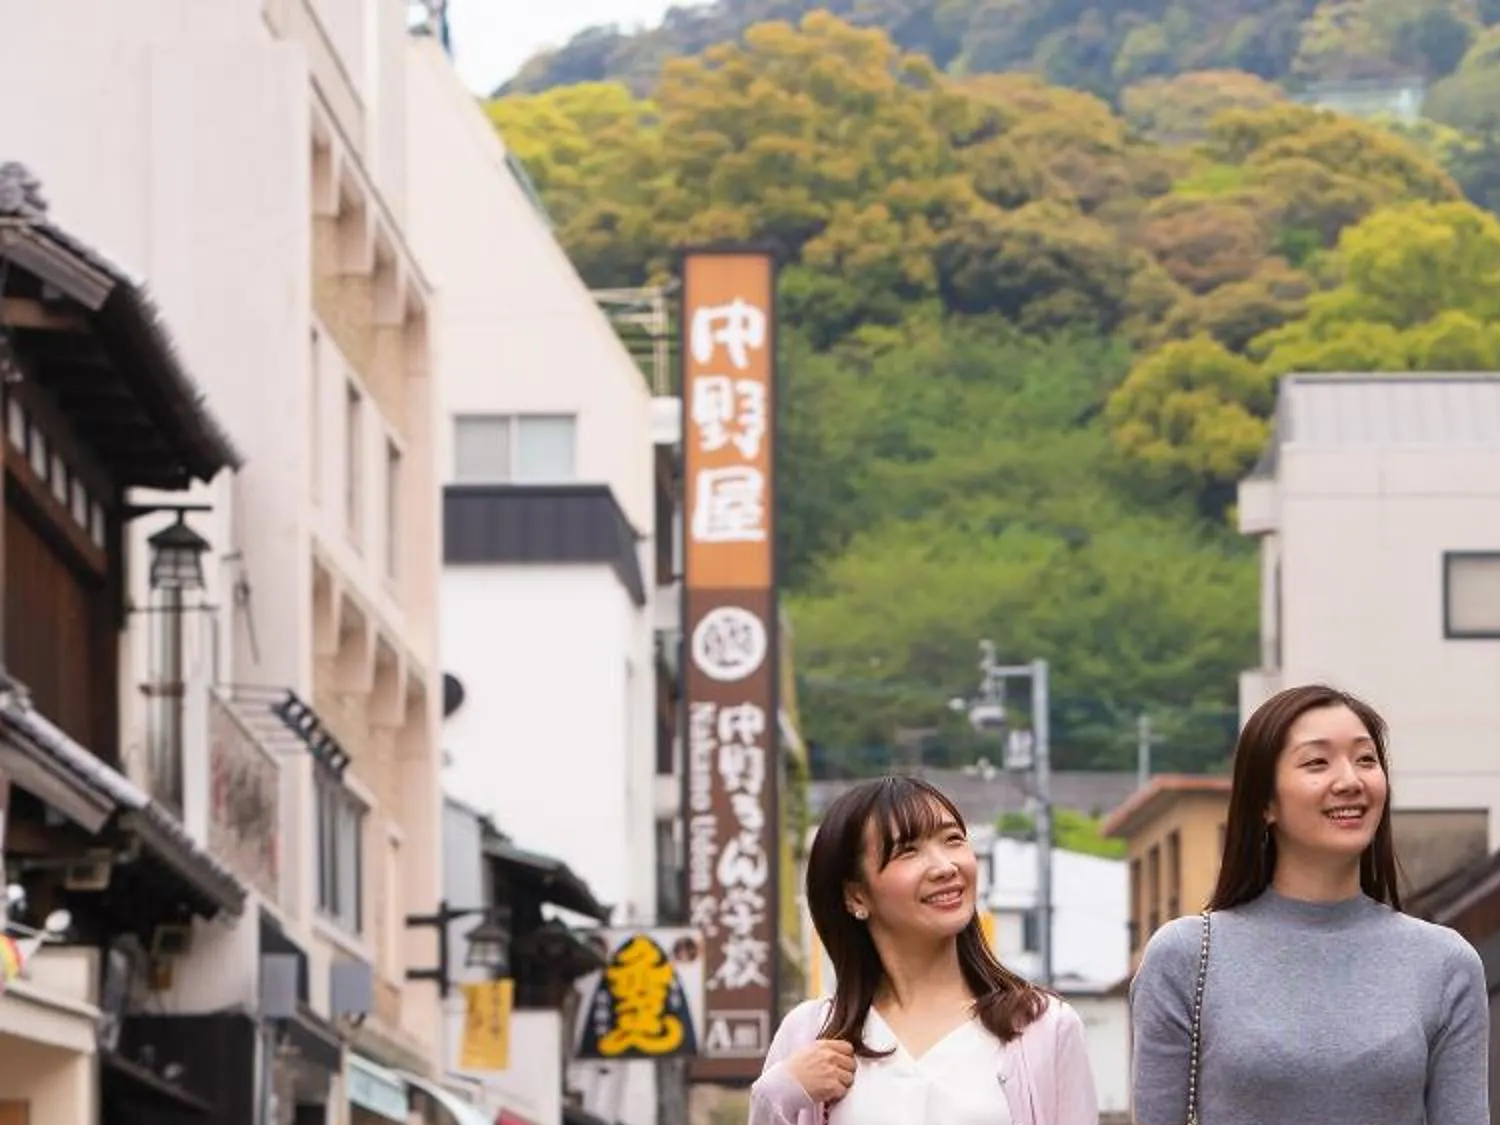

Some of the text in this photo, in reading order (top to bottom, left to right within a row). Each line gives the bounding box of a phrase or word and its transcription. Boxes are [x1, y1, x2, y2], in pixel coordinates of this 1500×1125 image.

[690, 297, 767, 542] 中野屋
[689, 701, 717, 812] Nakano
[689, 814, 718, 892] Udon
